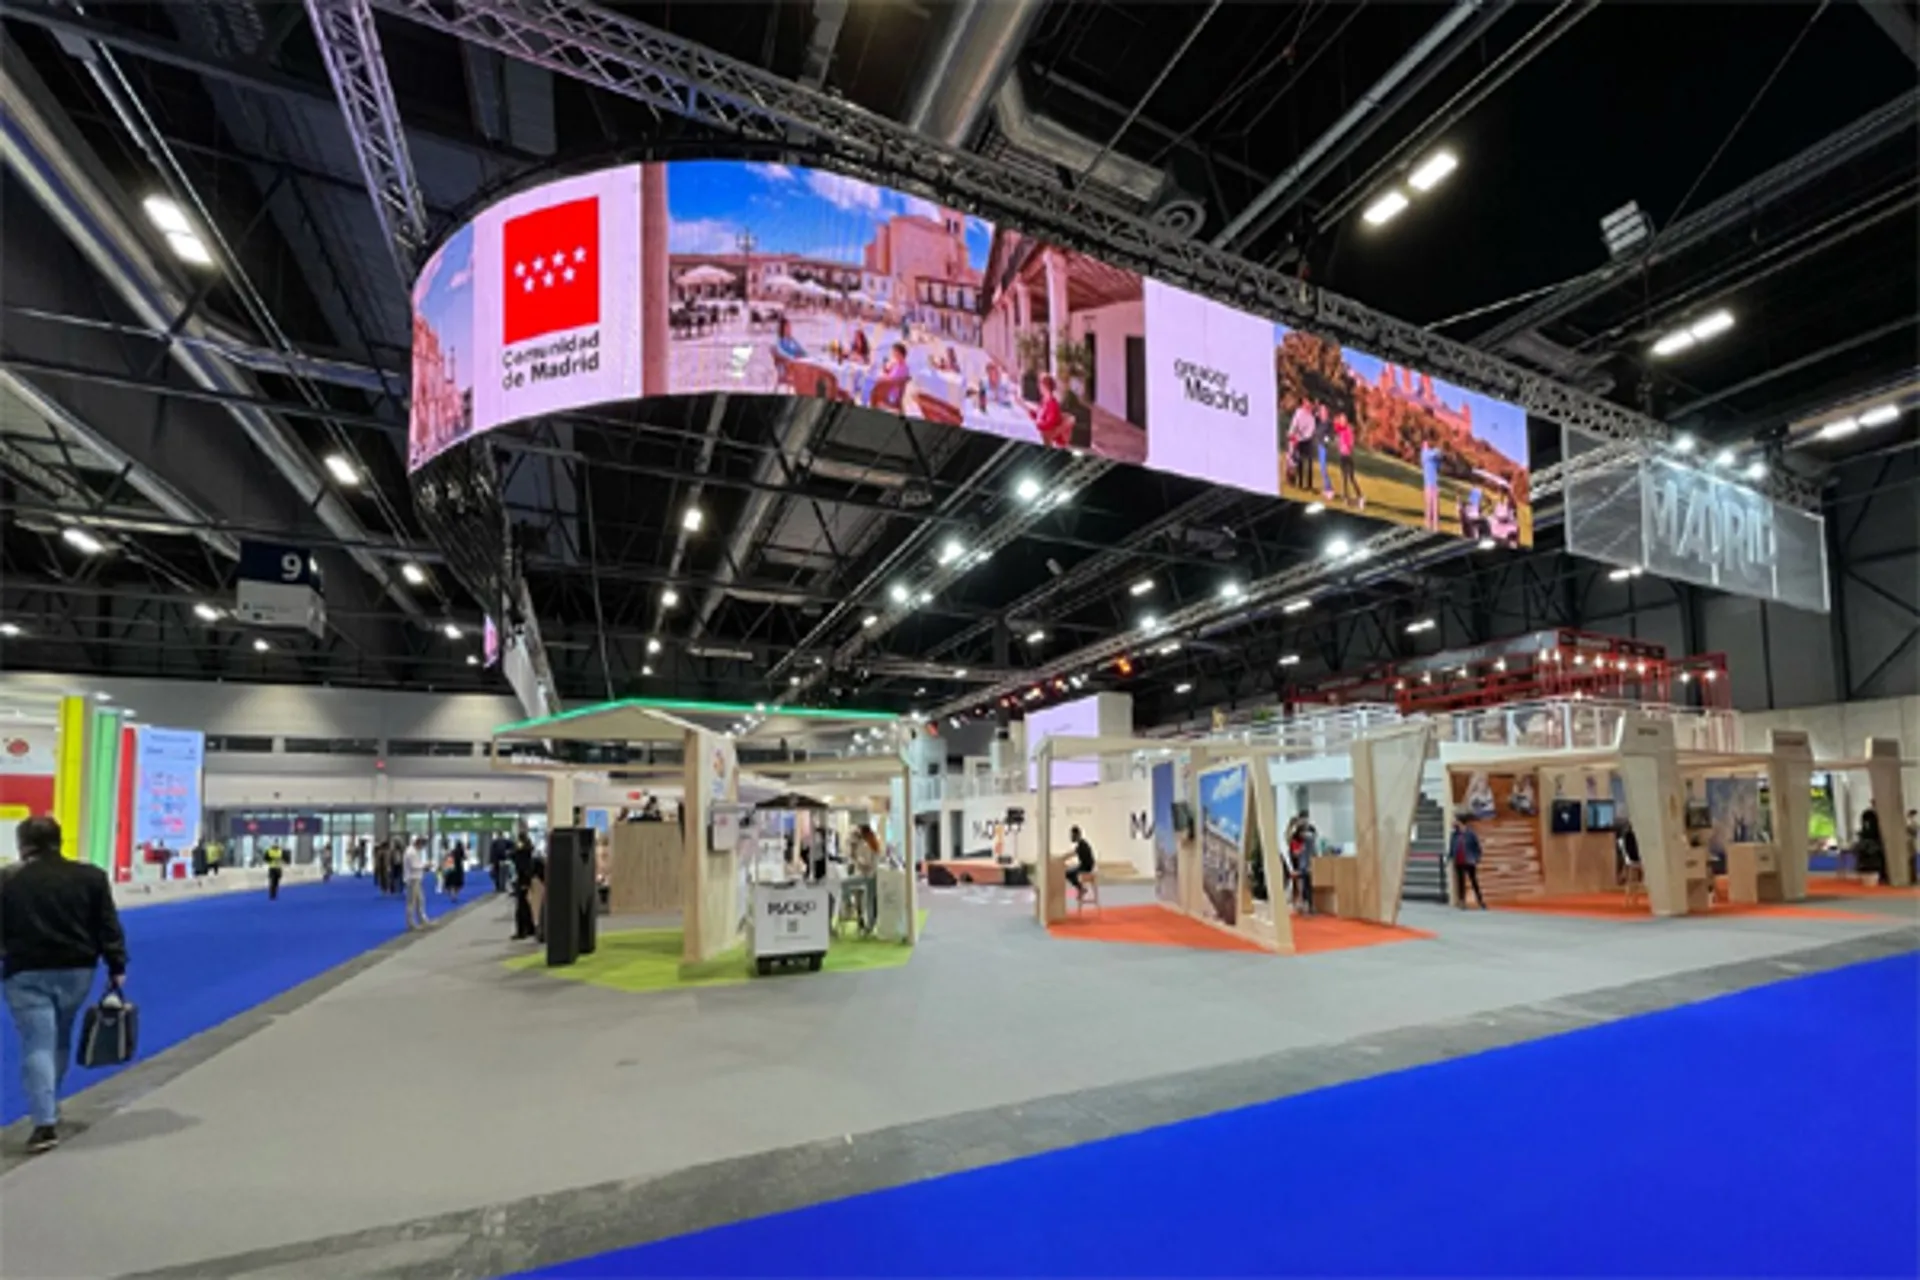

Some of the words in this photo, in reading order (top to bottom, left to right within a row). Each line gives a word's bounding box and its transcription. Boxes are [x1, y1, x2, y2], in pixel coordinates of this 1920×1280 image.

[502, 330, 600, 369] Comunidad
[502, 371, 525, 390] de
[531, 351, 599, 383] Madrid
[1184, 377, 1249, 418] Madrid
[281, 552, 302, 581] 9
